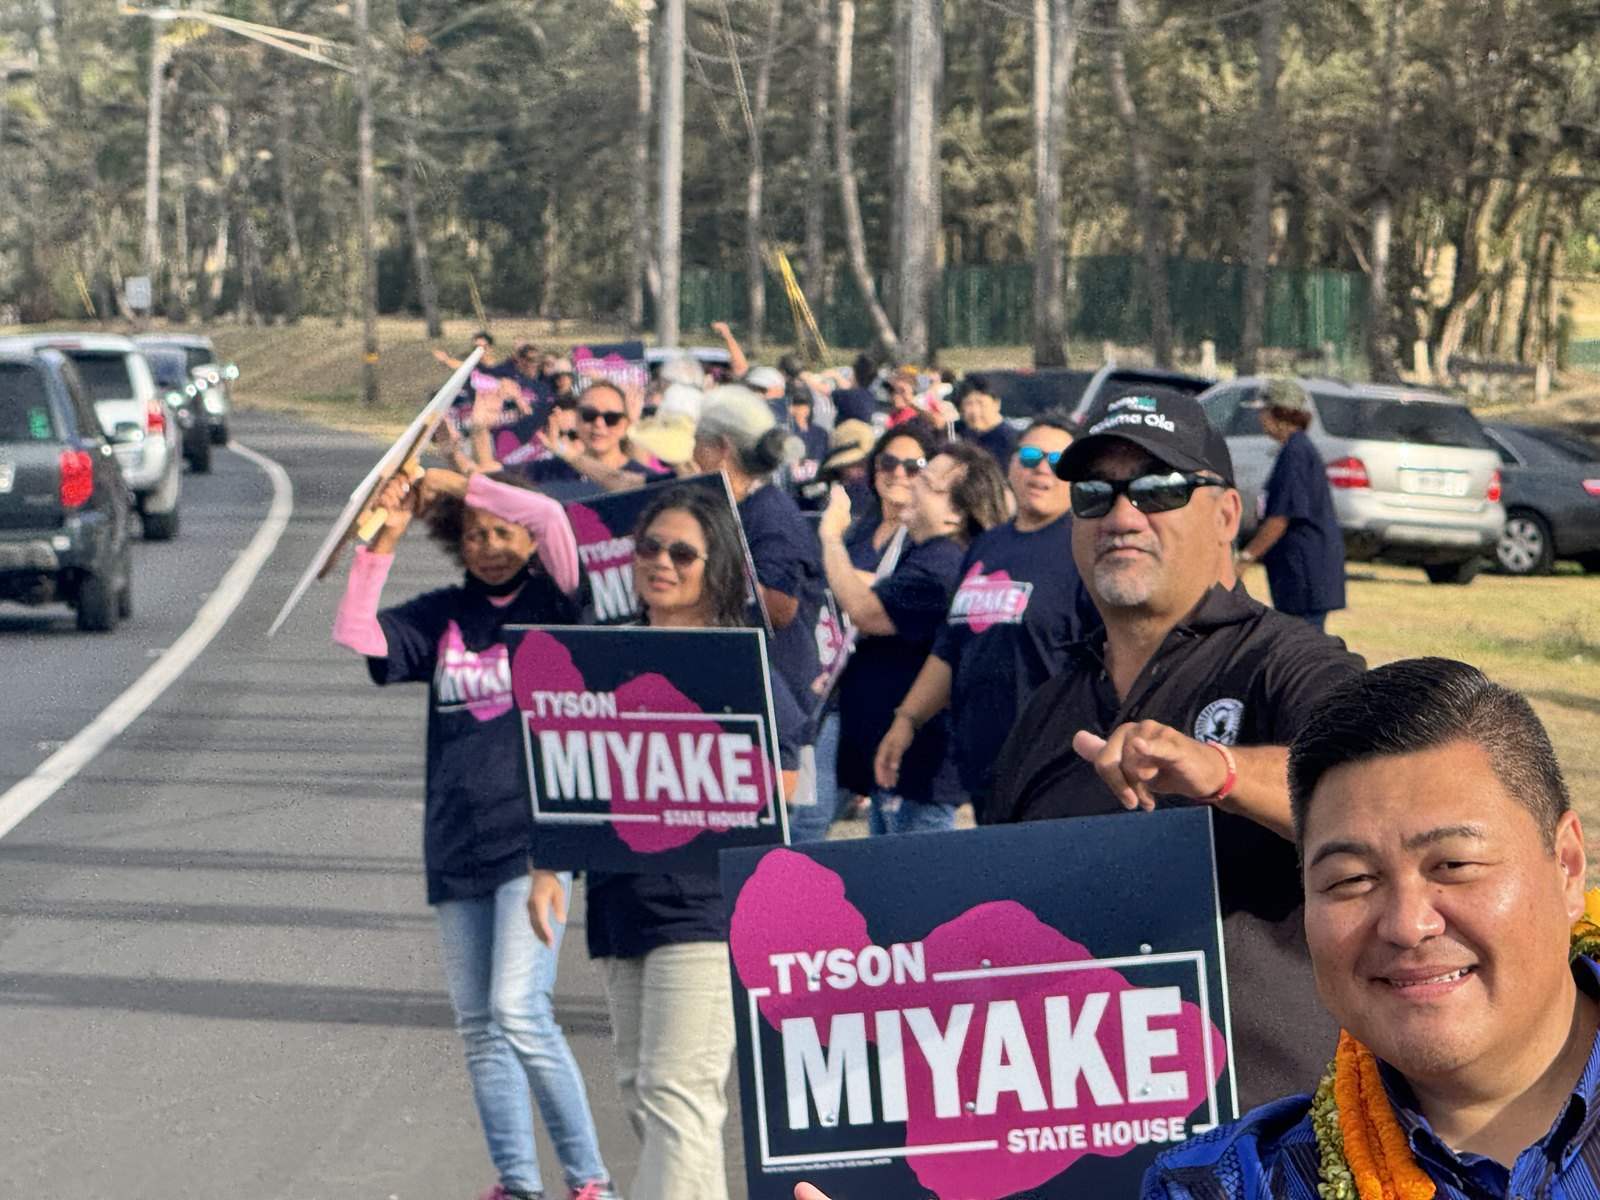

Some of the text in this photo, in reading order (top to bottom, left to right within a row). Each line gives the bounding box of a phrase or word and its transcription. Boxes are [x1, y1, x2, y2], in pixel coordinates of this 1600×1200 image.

[1145, 414, 1175, 432] Ola
[532, 691, 617, 719] TYSON
[540, 730, 758, 804] MIYAKE
[663, 809, 758, 829] STATE HOUSE
[770, 942, 926, 995] TYSON
[781, 986, 1189, 1130] MIYAKE
[1007, 1117, 1187, 1154] STATE HOUSE
